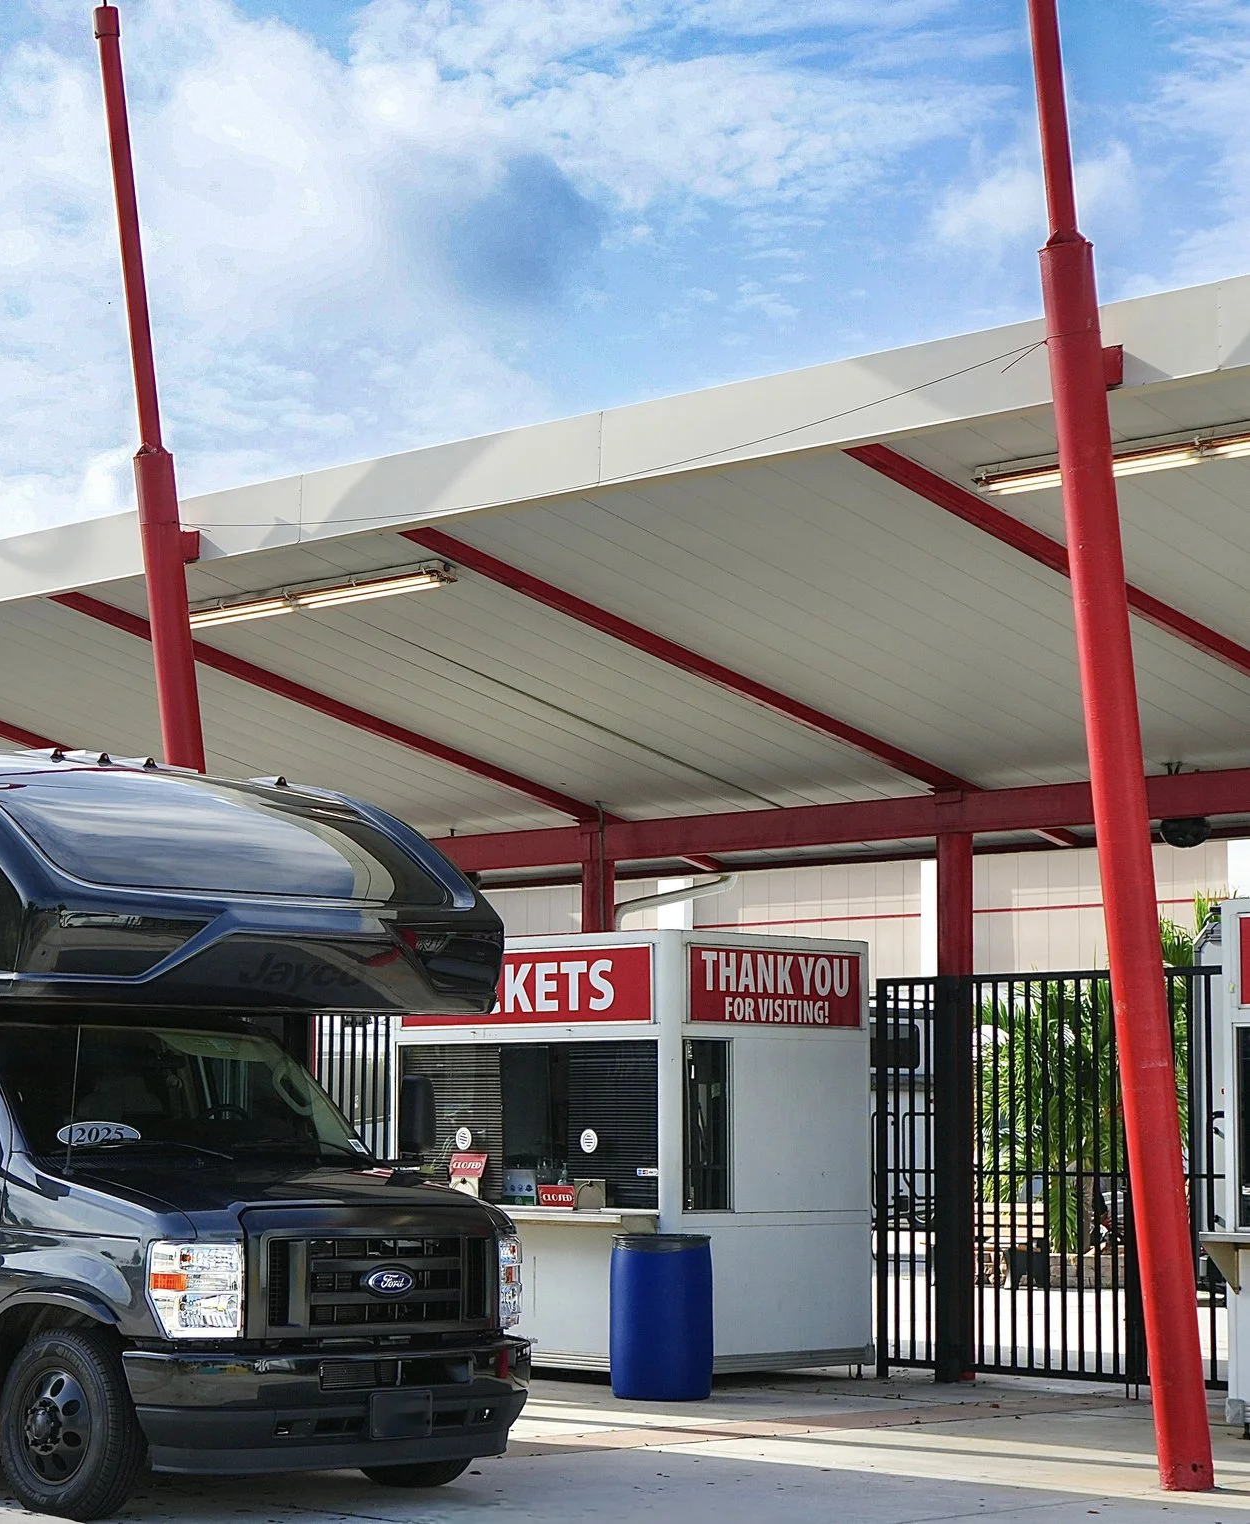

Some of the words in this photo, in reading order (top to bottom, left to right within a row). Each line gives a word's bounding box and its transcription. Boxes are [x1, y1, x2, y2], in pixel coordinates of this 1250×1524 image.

[701, 950, 794, 995] THANK
[796, 956, 850, 998] YOU
[488, 959, 615, 1014] KETS
[724, 996, 755, 1021] FOR
[756, 998, 829, 1025] VISITING!
[74, 1126, 125, 1143] 2025
[452, 1160, 482, 1169] CLOSED
[542, 1193, 573, 1202] CLOSED
[380, 1274, 405, 1288] Ford
